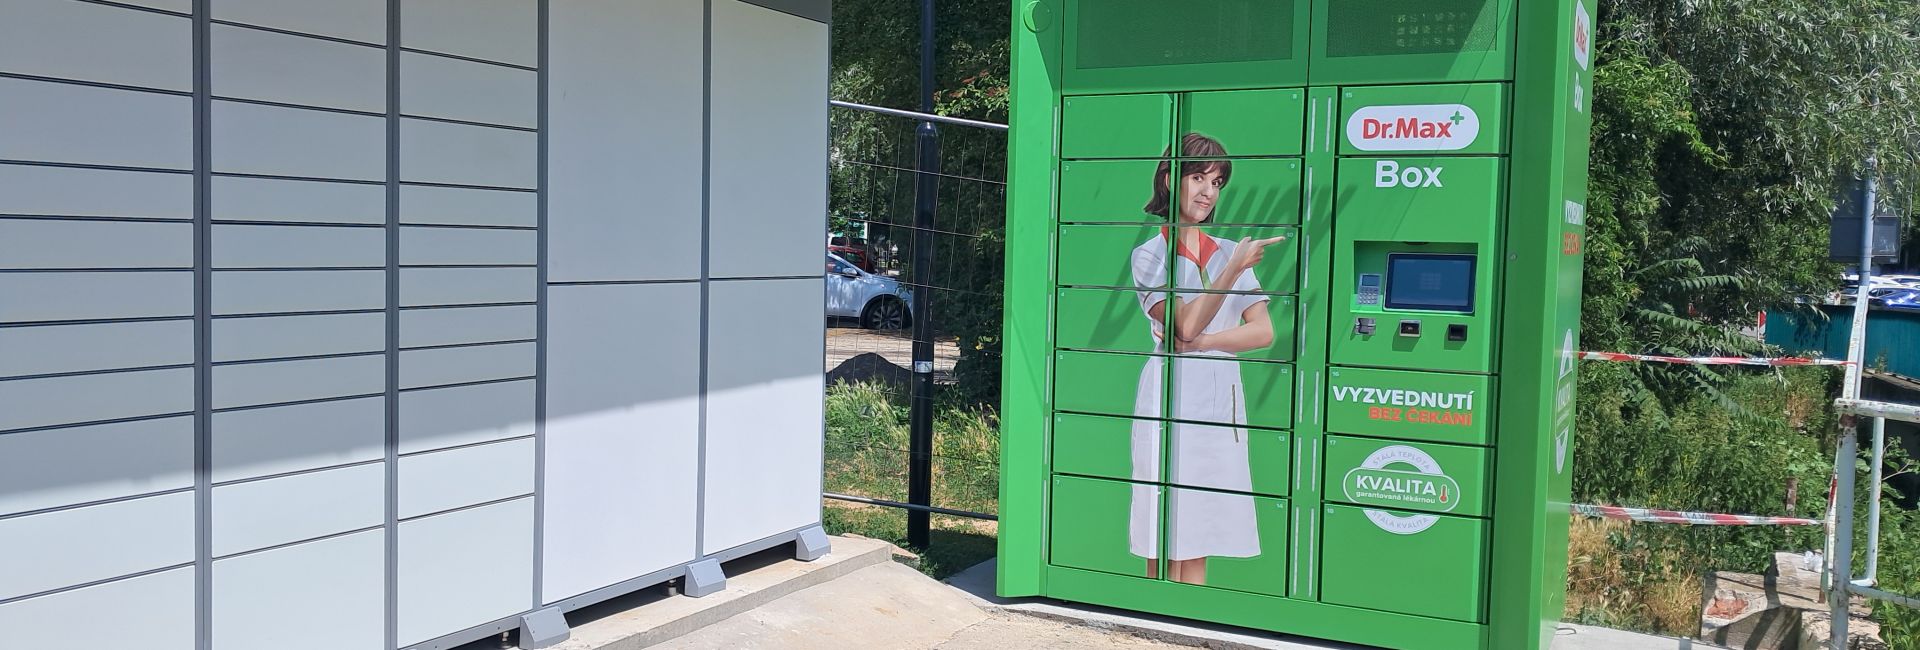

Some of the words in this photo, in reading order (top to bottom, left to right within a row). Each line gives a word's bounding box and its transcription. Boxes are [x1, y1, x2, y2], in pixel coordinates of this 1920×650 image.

[1362, 117, 1452, 139] Dr.Max
[1375, 160, 1444, 188] Box
[1332, 385, 1475, 410] VYZVEDNUTÍ
[1369, 406, 1402, 421] BEZ
[1405, 406, 1473, 427] ČEKÁNÍ
[1356, 474, 1437, 496] KVALITA
